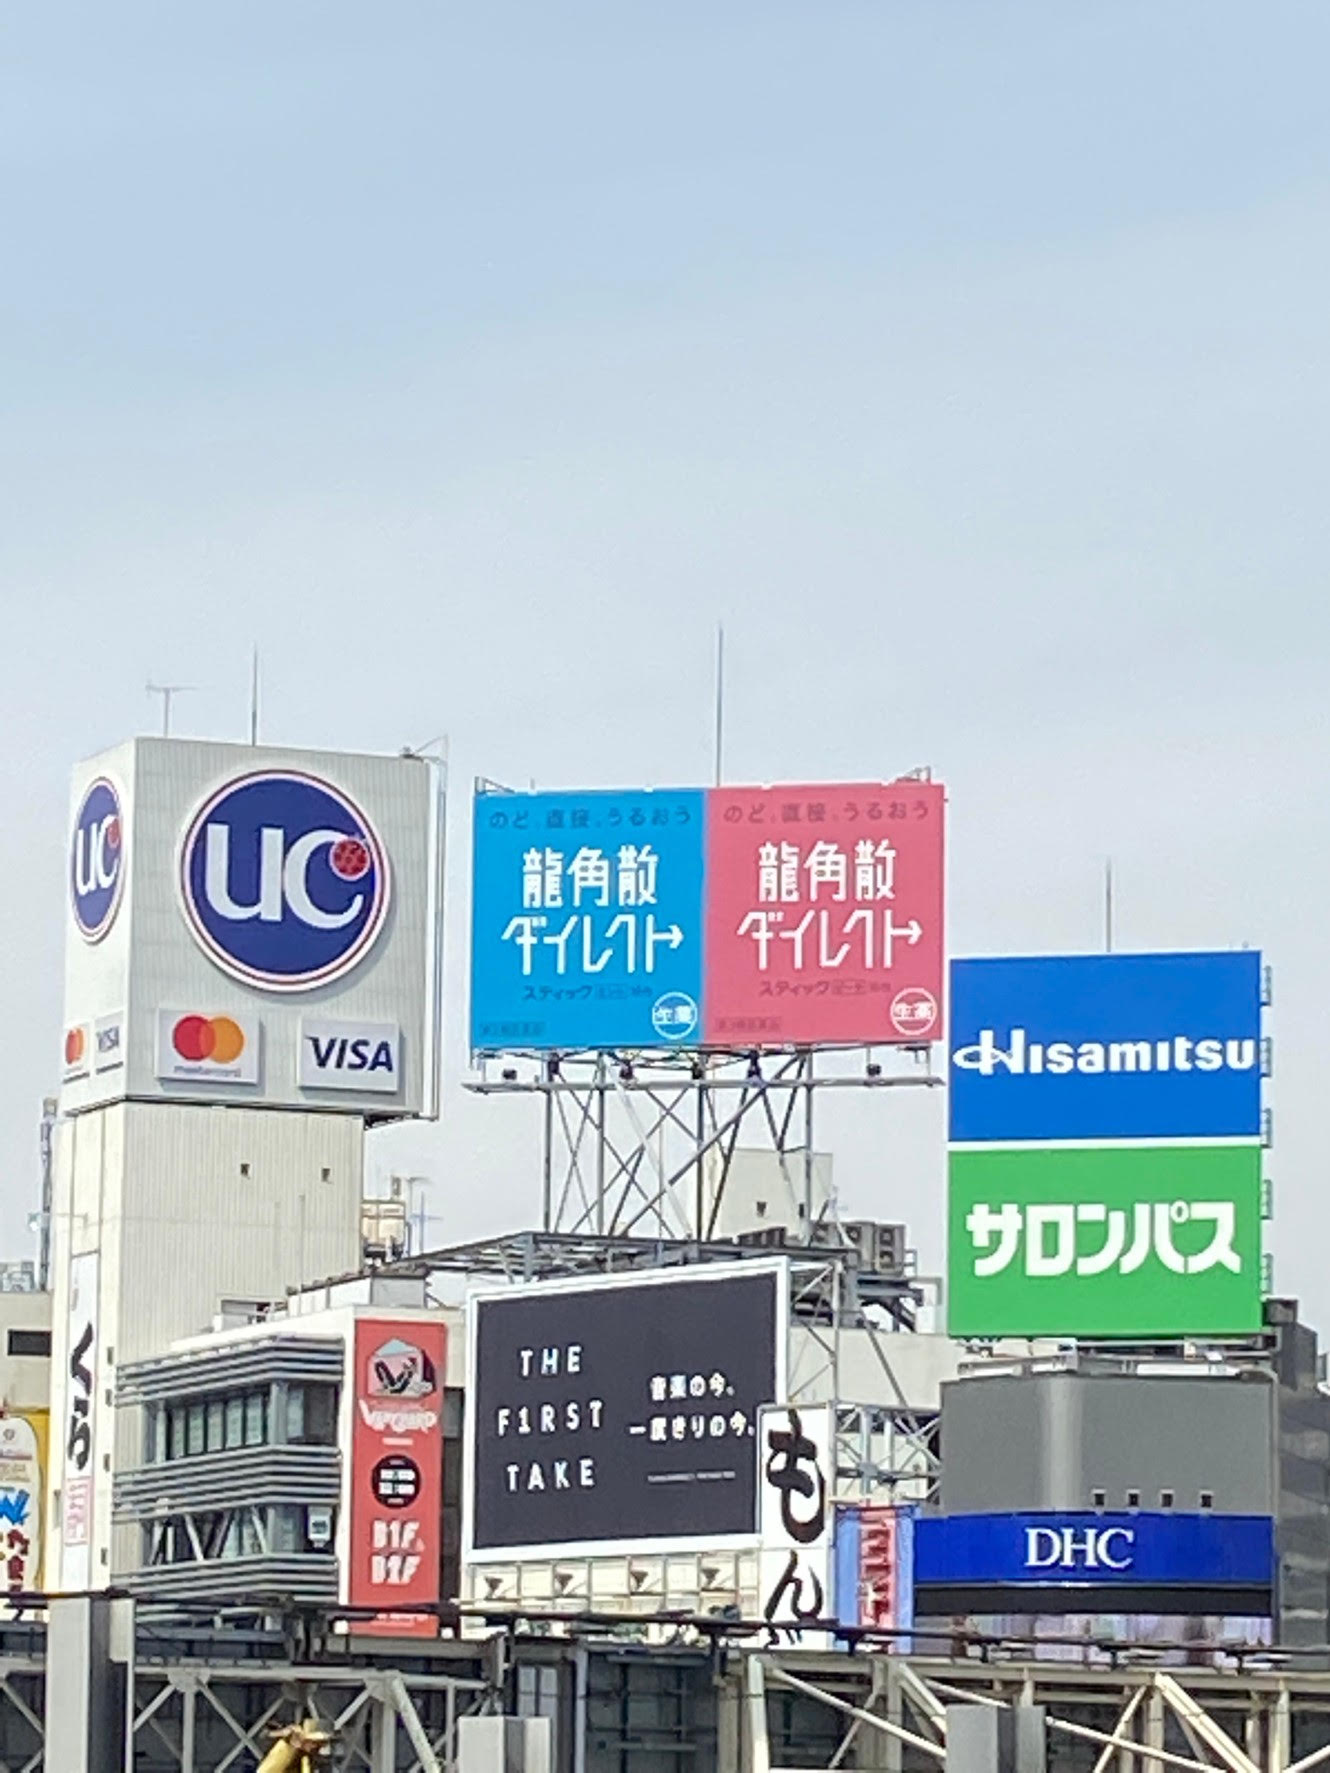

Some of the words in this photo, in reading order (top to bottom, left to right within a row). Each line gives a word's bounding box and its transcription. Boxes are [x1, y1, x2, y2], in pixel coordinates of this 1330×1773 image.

[75, 814, 120, 896] UC
[205, 822, 368, 929] UC
[522, 844, 659, 908] 龍角散
[757, 838, 897, 903] 龍角散
[501, 913, 684, 976] ダイレクト
[736, 908, 923, 972] ダイレクト
[306, 1036, 394, 1073] VISA
[952, 1028, 1256, 1075] Hisamitsu
[966, 1200, 1242, 1277] サロンパス
[520, 1345, 582, 1377] THE
[506, 1458, 595, 1492] TAKE
[1025, 1528, 1135, 1570] DHC
